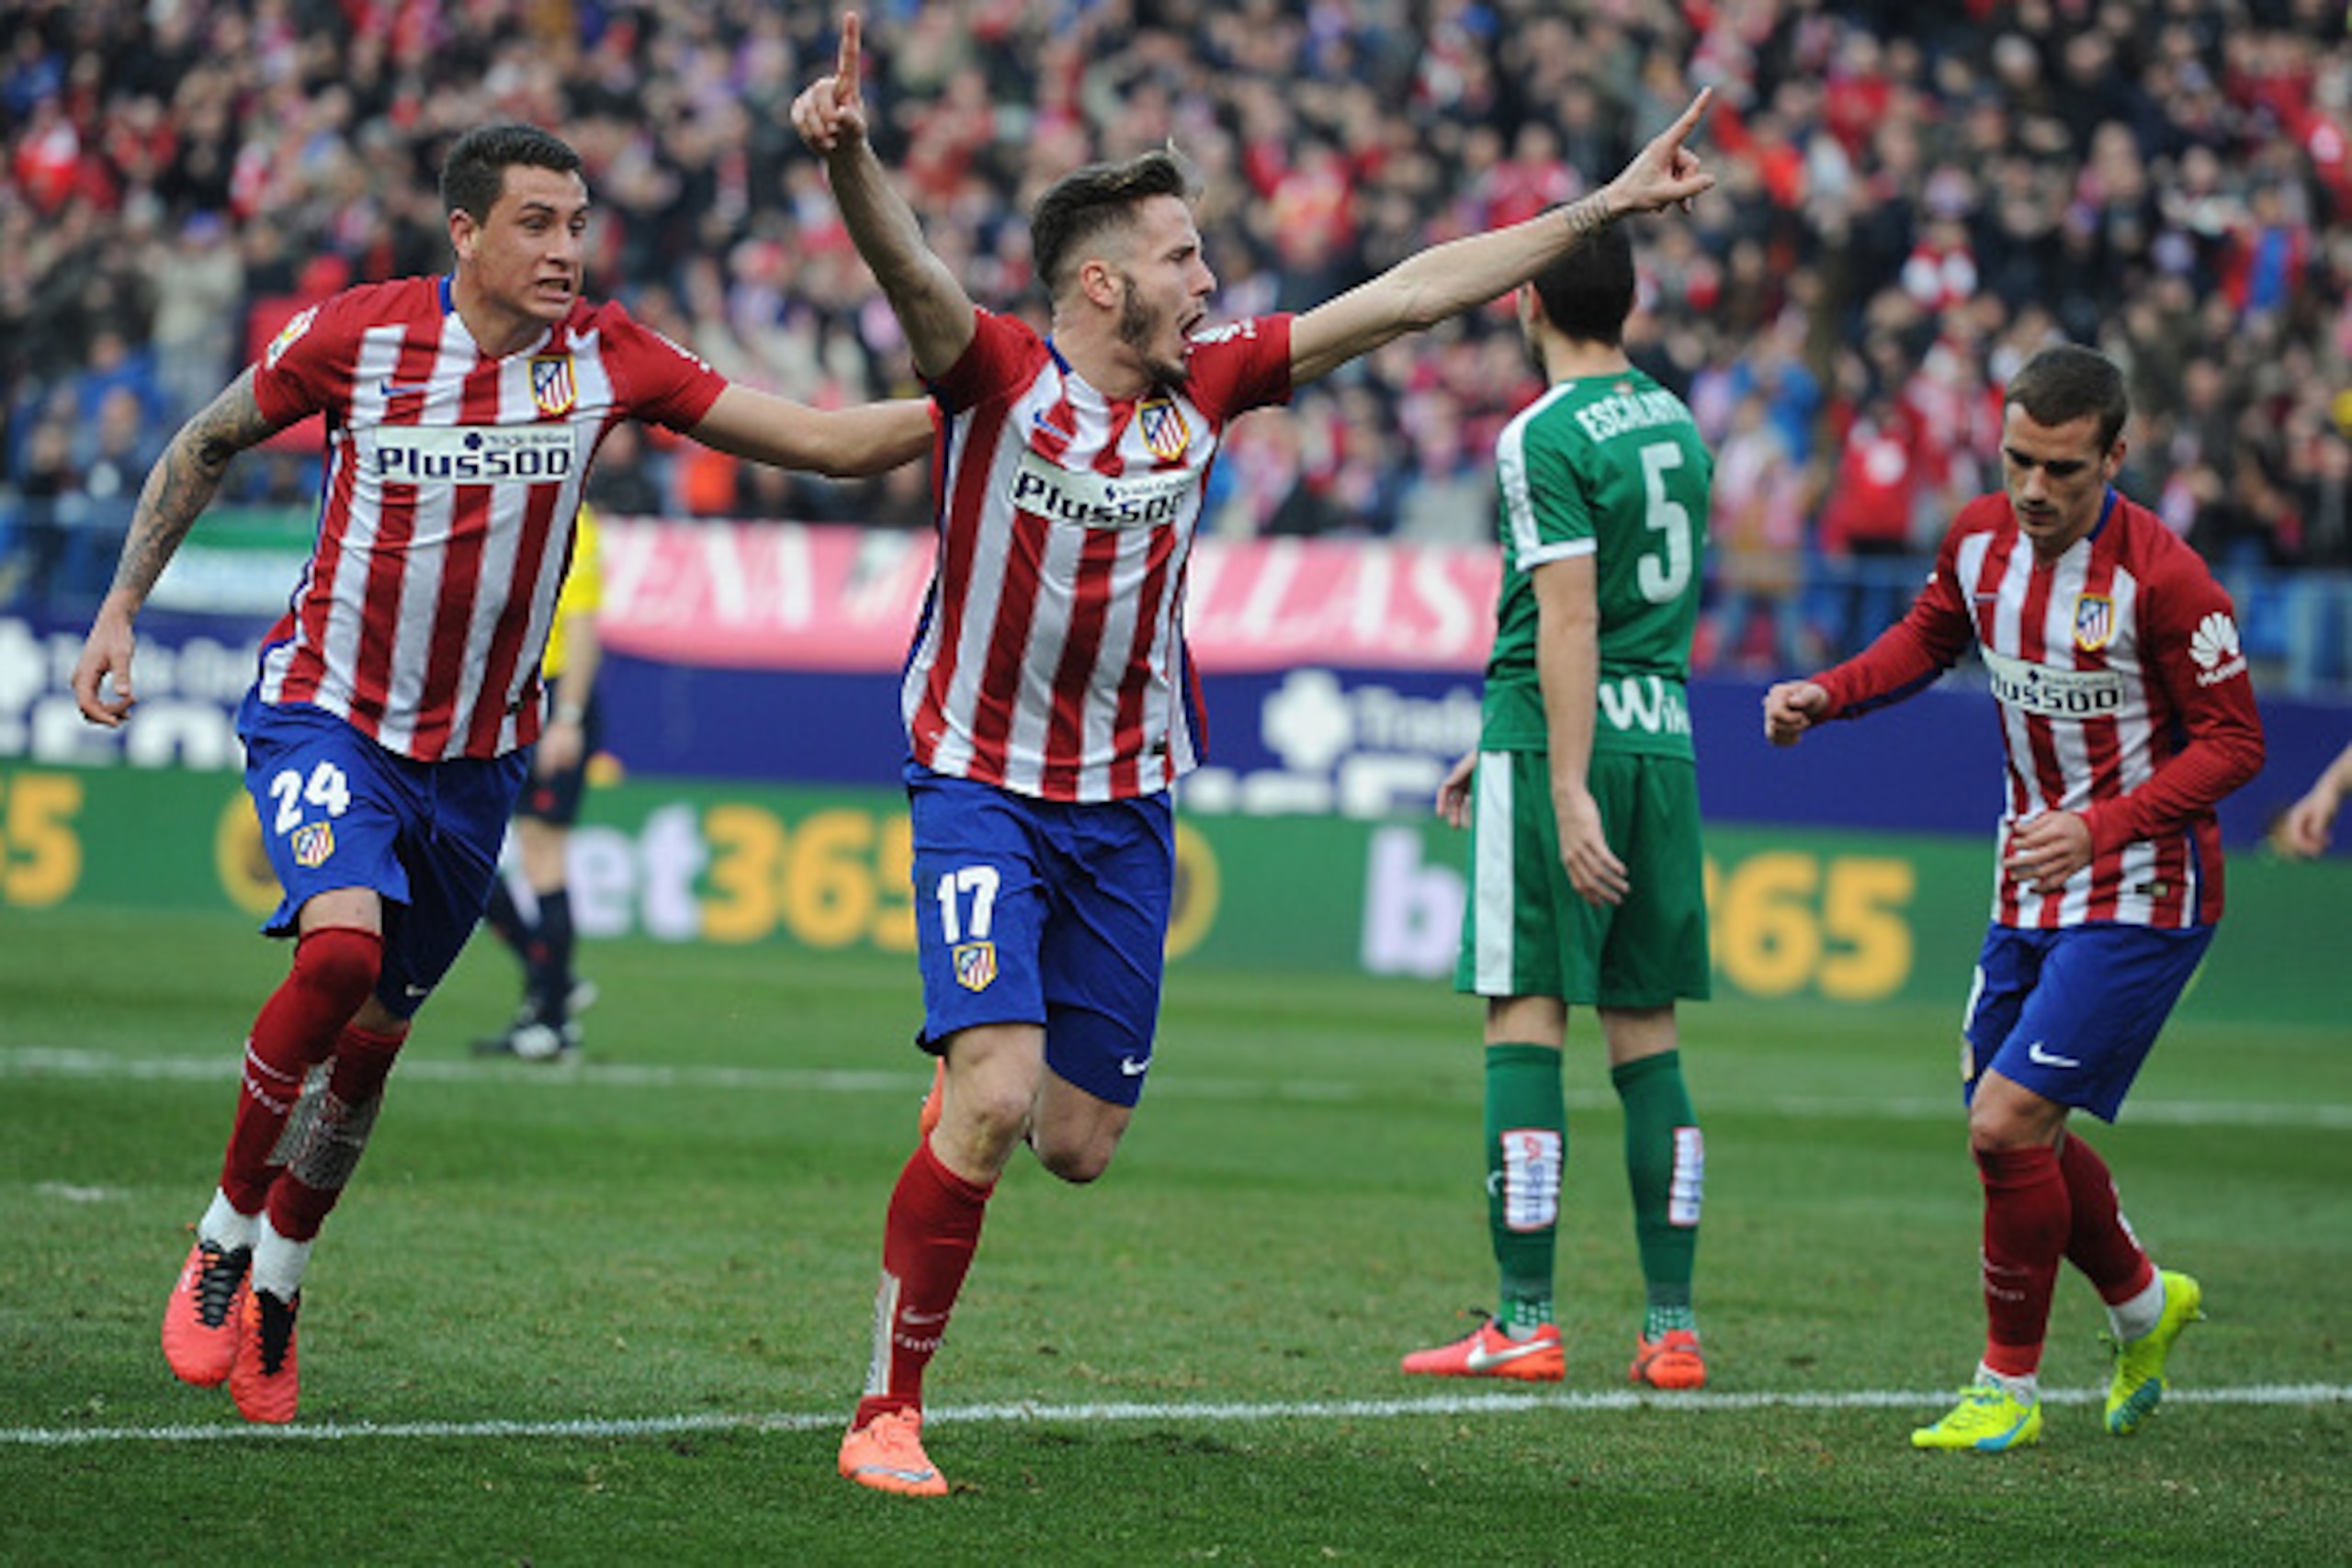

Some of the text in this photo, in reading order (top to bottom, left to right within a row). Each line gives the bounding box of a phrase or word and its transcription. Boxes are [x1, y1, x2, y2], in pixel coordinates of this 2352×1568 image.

[377, 446, 571, 479] Plus500
[1637, 441, 1693, 604] 5
[1995, 672, 2119, 713] lus500
[268, 759, 351, 836] 24
[936, 863, 1001, 945] 17
